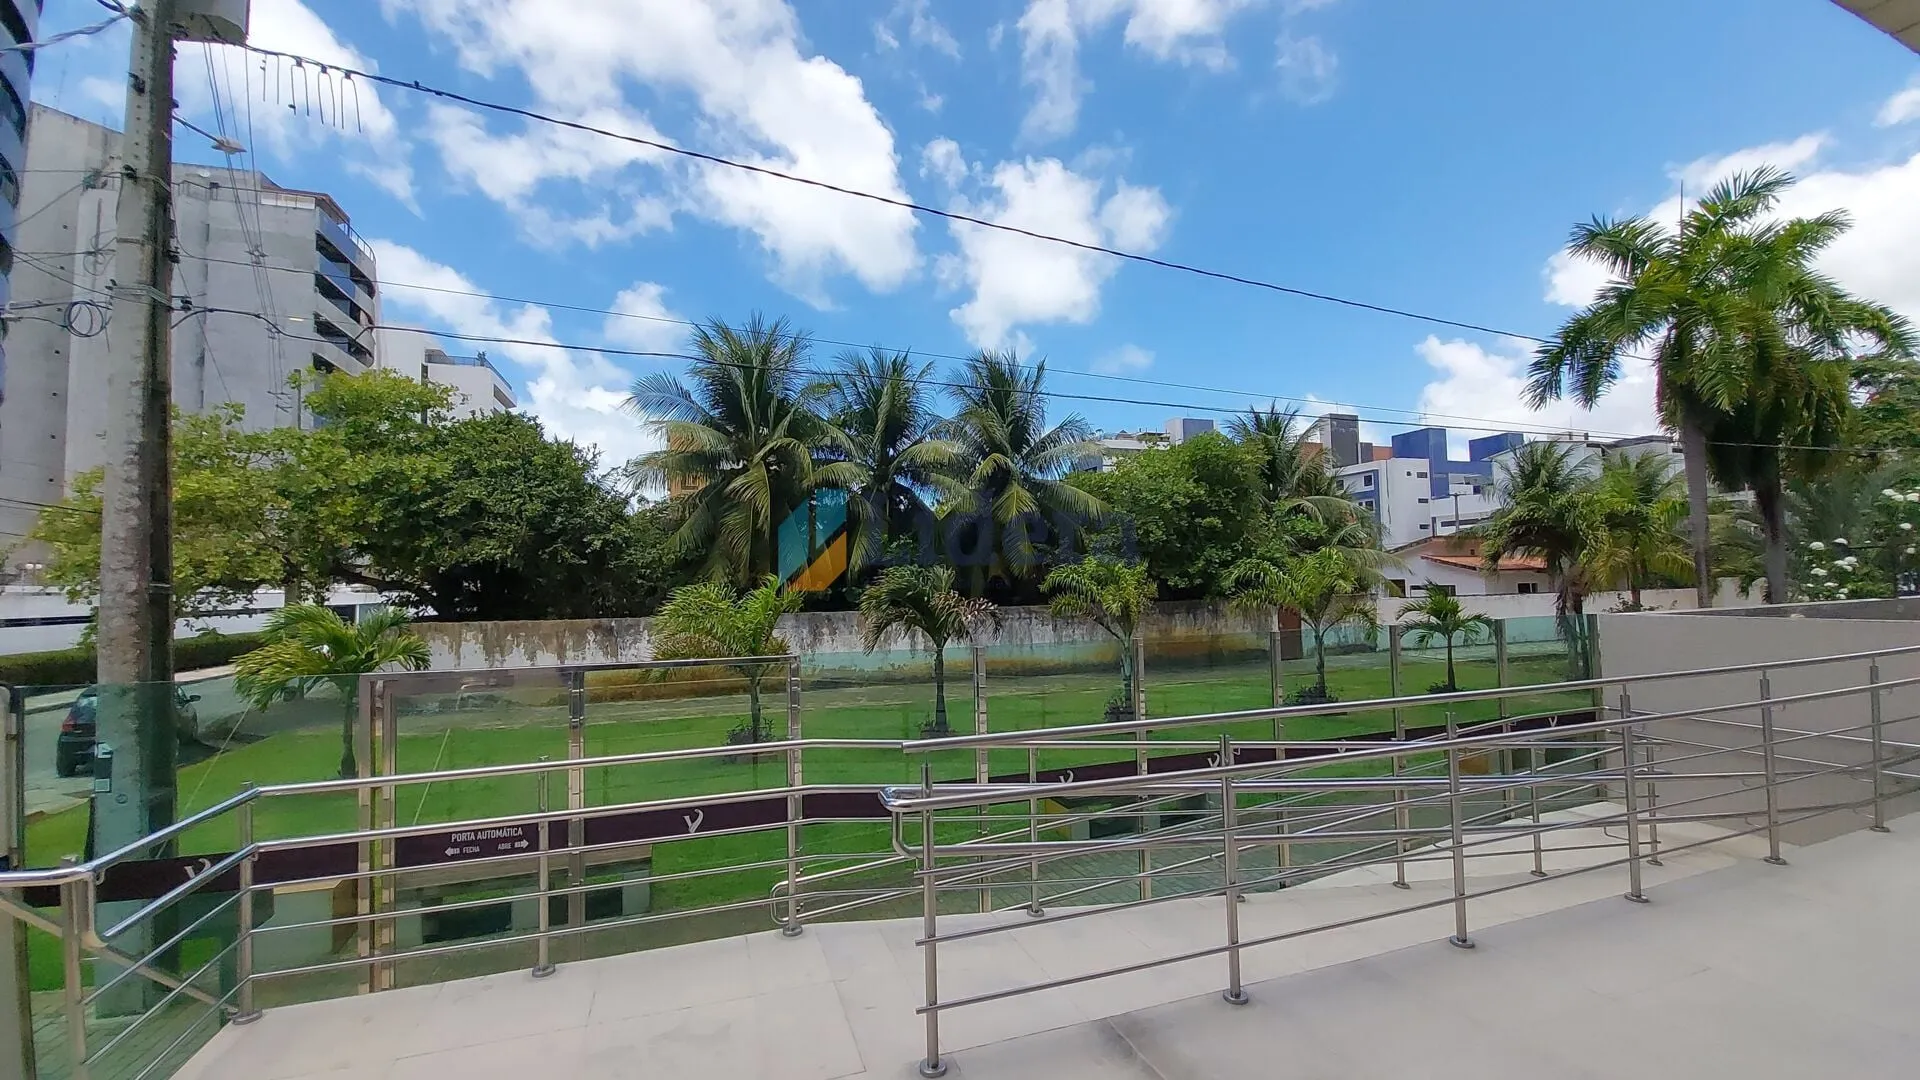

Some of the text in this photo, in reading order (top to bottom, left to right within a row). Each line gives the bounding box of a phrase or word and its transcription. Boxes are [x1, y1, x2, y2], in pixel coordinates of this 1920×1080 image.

[451, 827, 523, 843] PORTA AUTOMÁTICA
[463, 842, 511, 854] FECHA ABRE
